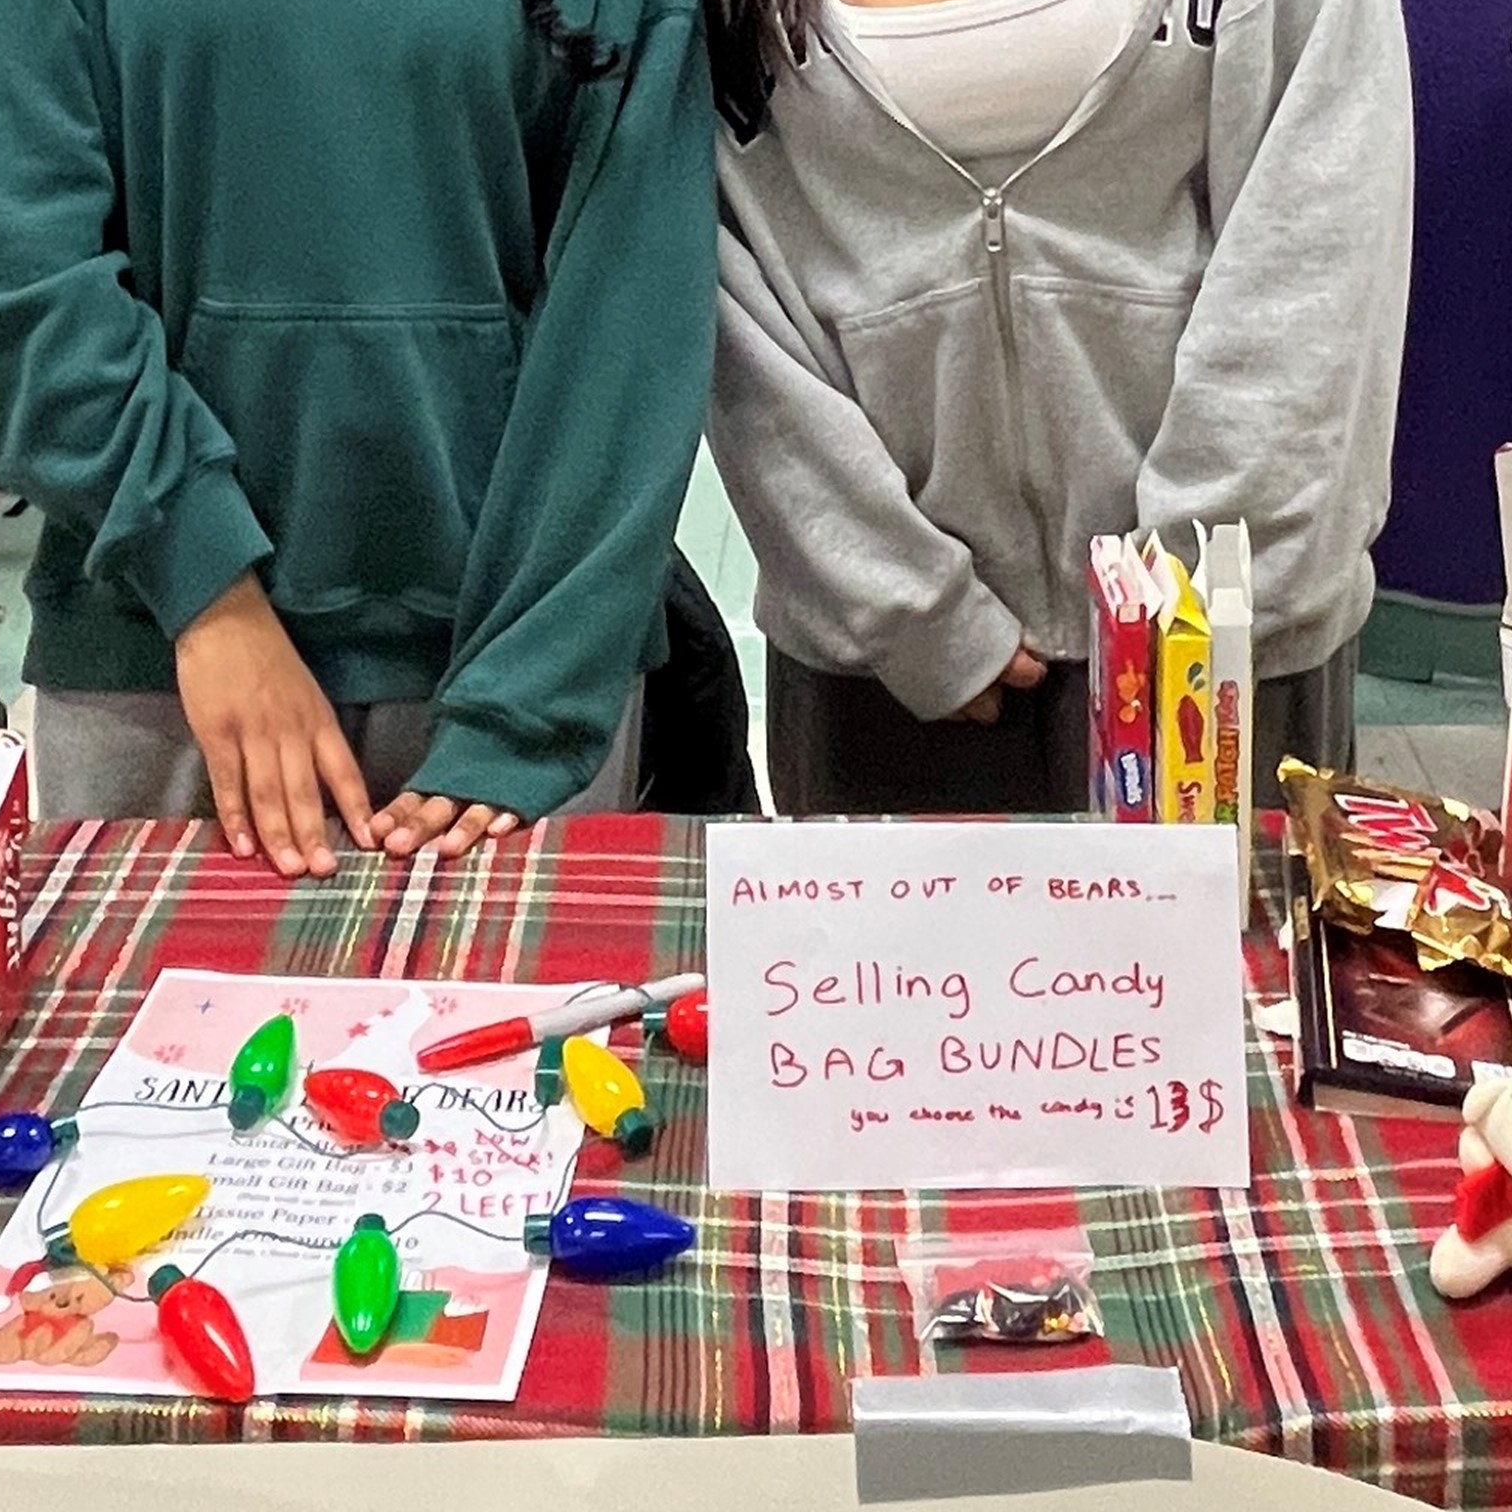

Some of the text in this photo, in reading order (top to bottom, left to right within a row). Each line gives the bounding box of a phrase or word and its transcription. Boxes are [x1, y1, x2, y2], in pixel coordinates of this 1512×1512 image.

[890, 877, 957, 899] OUT
[987, 876, 1023, 895] OF
[763, 956, 1164, 1019] Selling Candy
[769, 1031, 1162, 1088] BAG BUNDLES
[850, 1108, 890, 1132] you
[989, 1102, 1022, 1121] the
[1041, 1098, 1104, 1120] candy
[278, 1155, 317, 1170] Gift
[209, 1175, 263, 1188] mall
[269, 1176, 309, 1190] Gift
[271, 1208, 338, 1226] Paper
